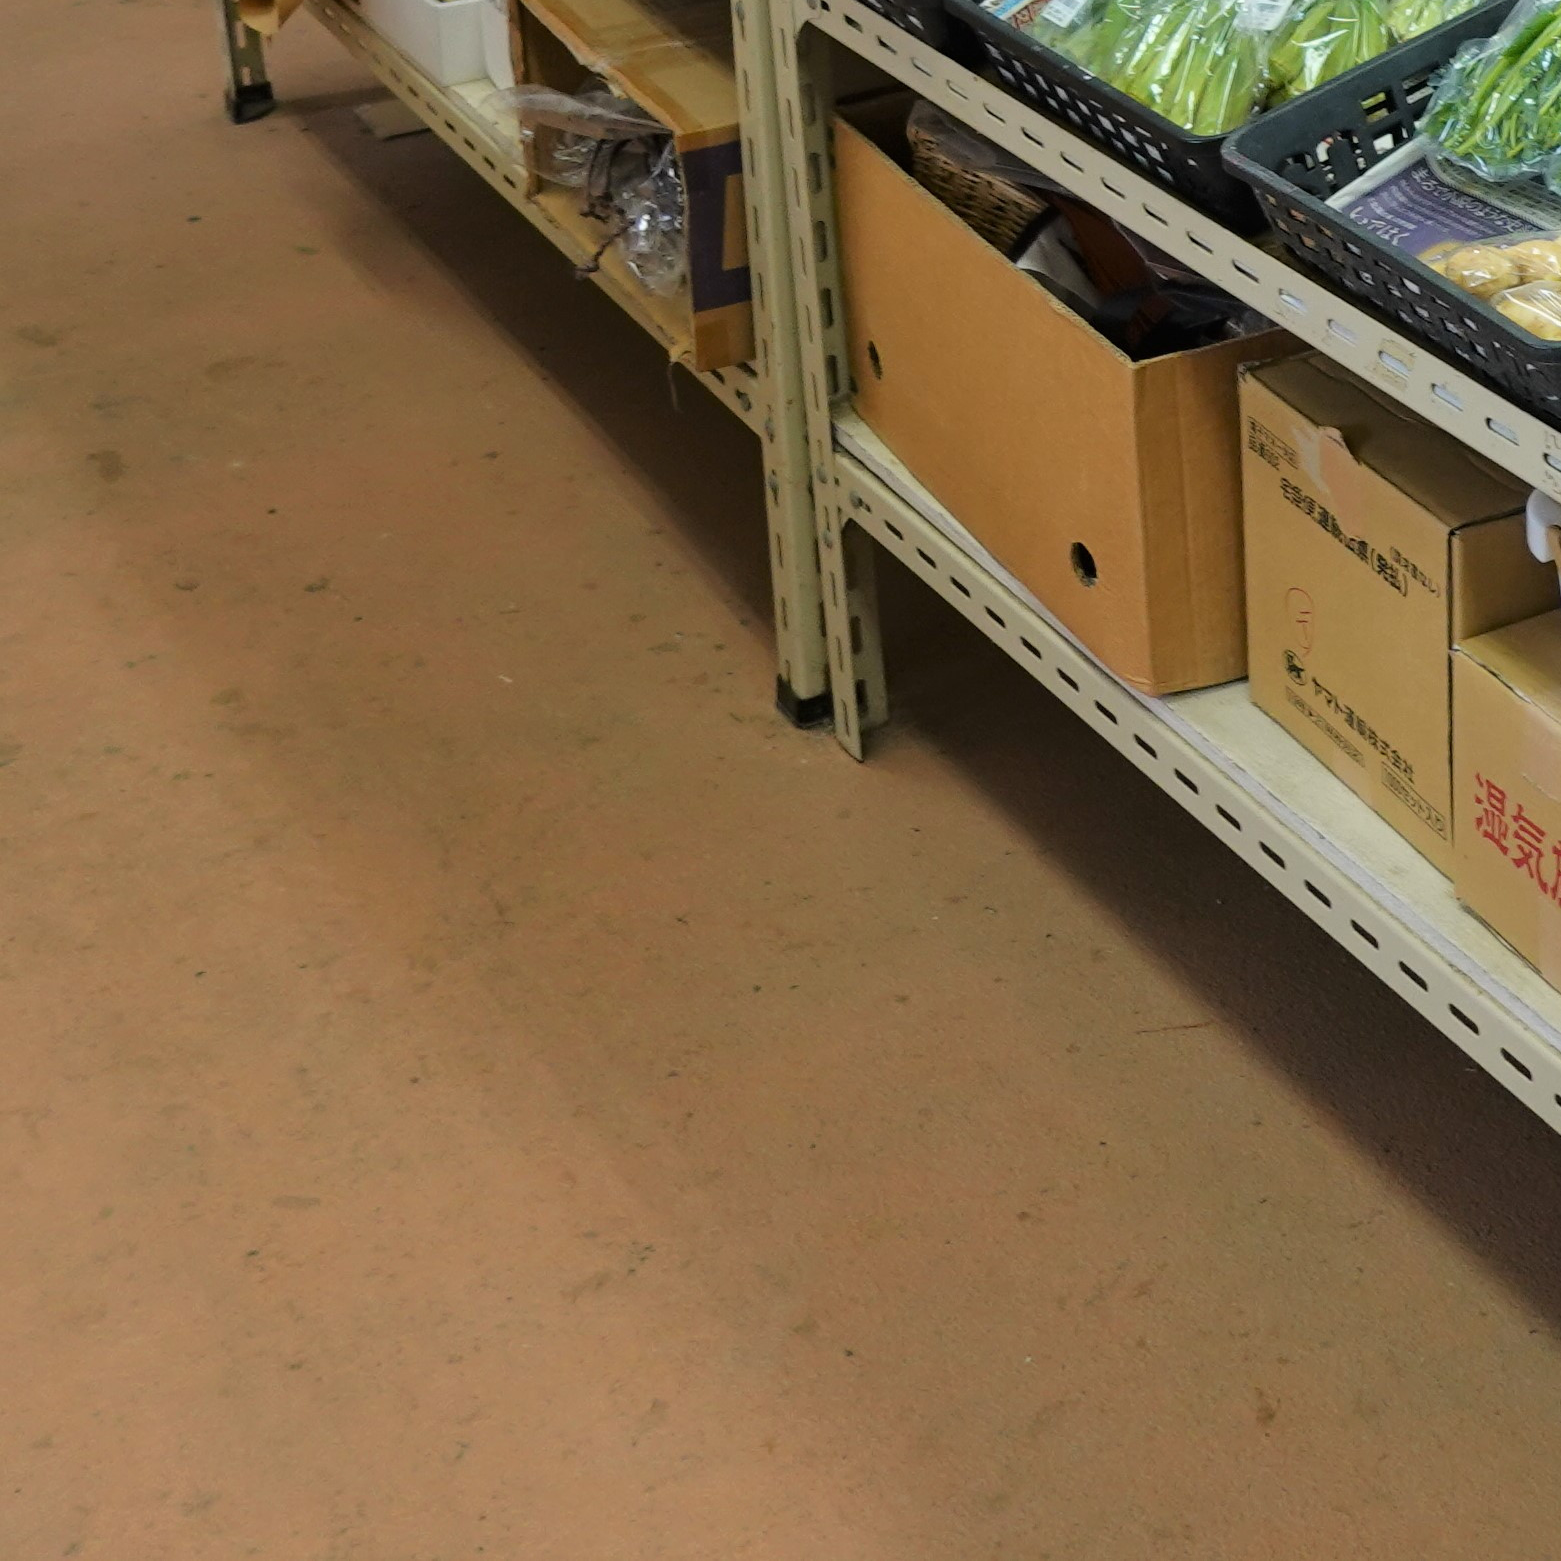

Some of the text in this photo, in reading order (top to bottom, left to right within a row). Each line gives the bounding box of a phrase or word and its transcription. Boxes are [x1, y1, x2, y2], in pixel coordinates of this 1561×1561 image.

[1311, 676, 1416, 786] ヤマト運輸株式会社
